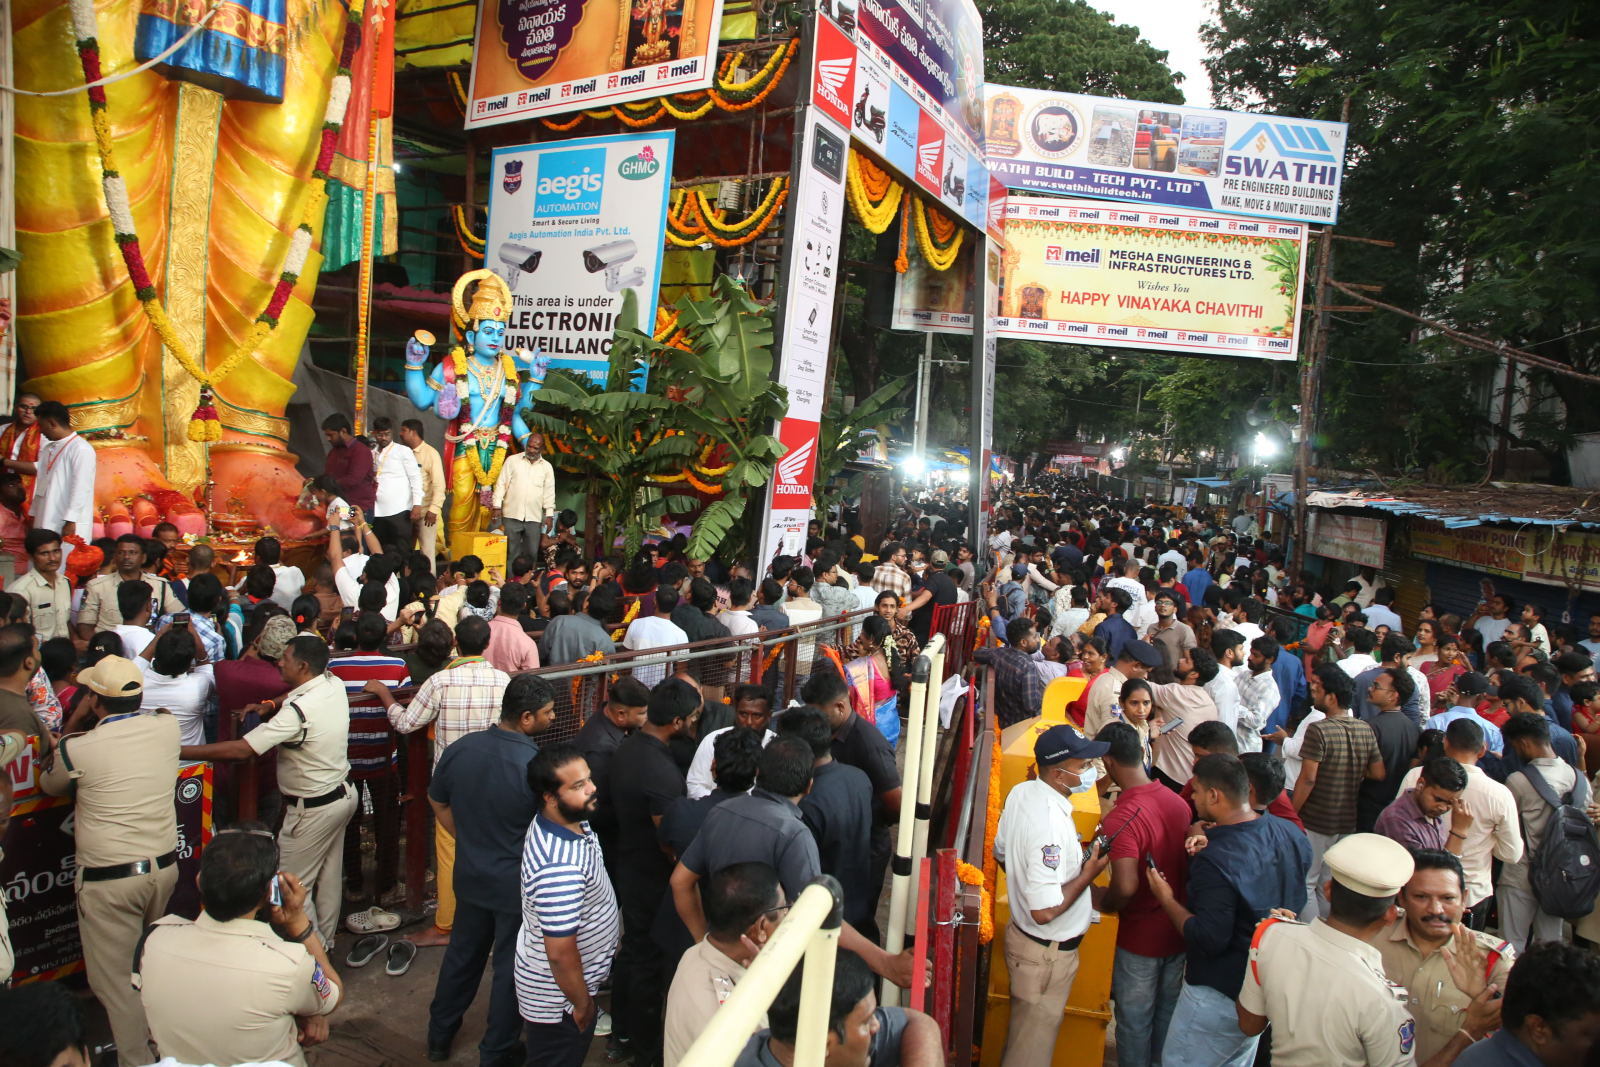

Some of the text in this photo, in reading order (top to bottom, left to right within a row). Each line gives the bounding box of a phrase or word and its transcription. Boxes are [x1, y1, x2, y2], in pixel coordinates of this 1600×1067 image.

[518, 4, 566, 31] వినాయక
[526, 26, 554, 45] చవితి
[487, 60, 697, 110] meil meil meil meil meil
[817, 82, 849, 116] HONDA
[622, 161, 655, 175] GHMC
[918, 164, 940, 188] HONDA
[986, 160, 1030, 176] WATHI
[1035, 166, 1074, 180] BUILD
[1093, 172, 1125, 186] TECH
[1130, 177, 1162, 190] PVT.
[1225, 155, 1337, 186] SWATHI
[537, 167, 602, 200] aegis
[1022, 178, 1152, 199] www.swathibuildtech.in
[1224, 178, 1334, 200] PRE ENGINEERED BUILDINGS
[536, 201, 599, 213] AUTOMATION
[1221, 196, 1331, 218] MAKE, MOVE & MOUNT BUILDING
[1040, 208, 1059, 217] meil
[1080, 211, 1099, 219] meil
[1120, 214, 1139, 222] meil
[1160, 217, 1179, 225] meil
[1200, 220, 1219, 229] meil
[1239, 224, 1258, 232] meil
[508, 226, 630, 240] Aegis Automation India Pvt. Ltd.
[1065, 249, 1100, 263] meil
[1109, 250, 1252, 269] MEGHA ENGINEERING &
[1109, 260, 1254, 280] INFRASTRUCTURES LTD.
[1137, 280, 1190, 293] Wishes You
[512, 295, 614, 307] This area is under
[1060, 290, 1263, 318] HAPPY VINAYAKA CHAVITHI
[1148, 331, 1168, 339] meil
[1228, 337, 1248, 345] meil
[1268, 340, 1288, 348] meil
[776, 484, 809, 494] HONDA
[1491, 534, 1527, 548] POINT
